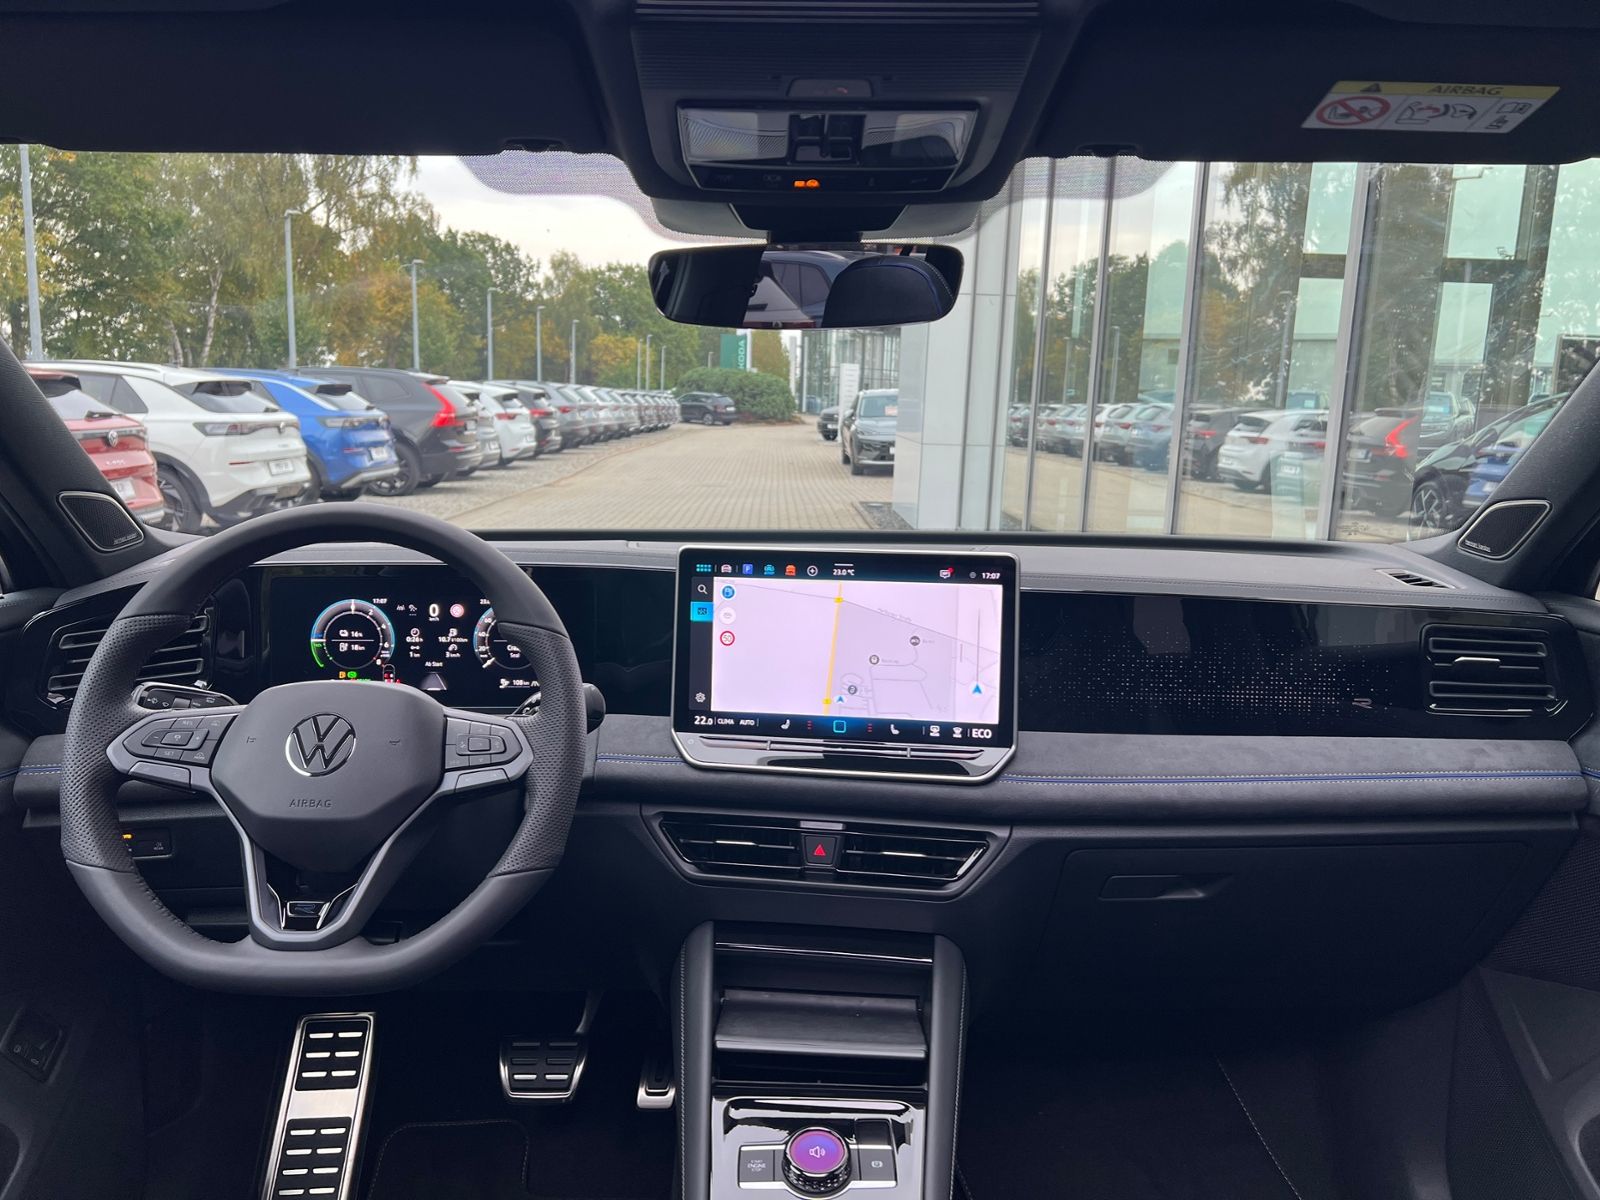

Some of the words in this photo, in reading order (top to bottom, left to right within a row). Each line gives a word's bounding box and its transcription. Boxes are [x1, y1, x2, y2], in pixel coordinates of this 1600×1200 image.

[1427, 84, 1505, 96] AIRBAG
[737, 339, 745, 369] KODA
[981, 572, 1001, 580] 17:07
[428, 603, 440, 617] 0
[693, 715, 714, 726] 22.0
[716, 717, 735, 725] CLIMA
[971, 728, 993, 739] ECO
[288, 799, 332, 809] AIRBAG
